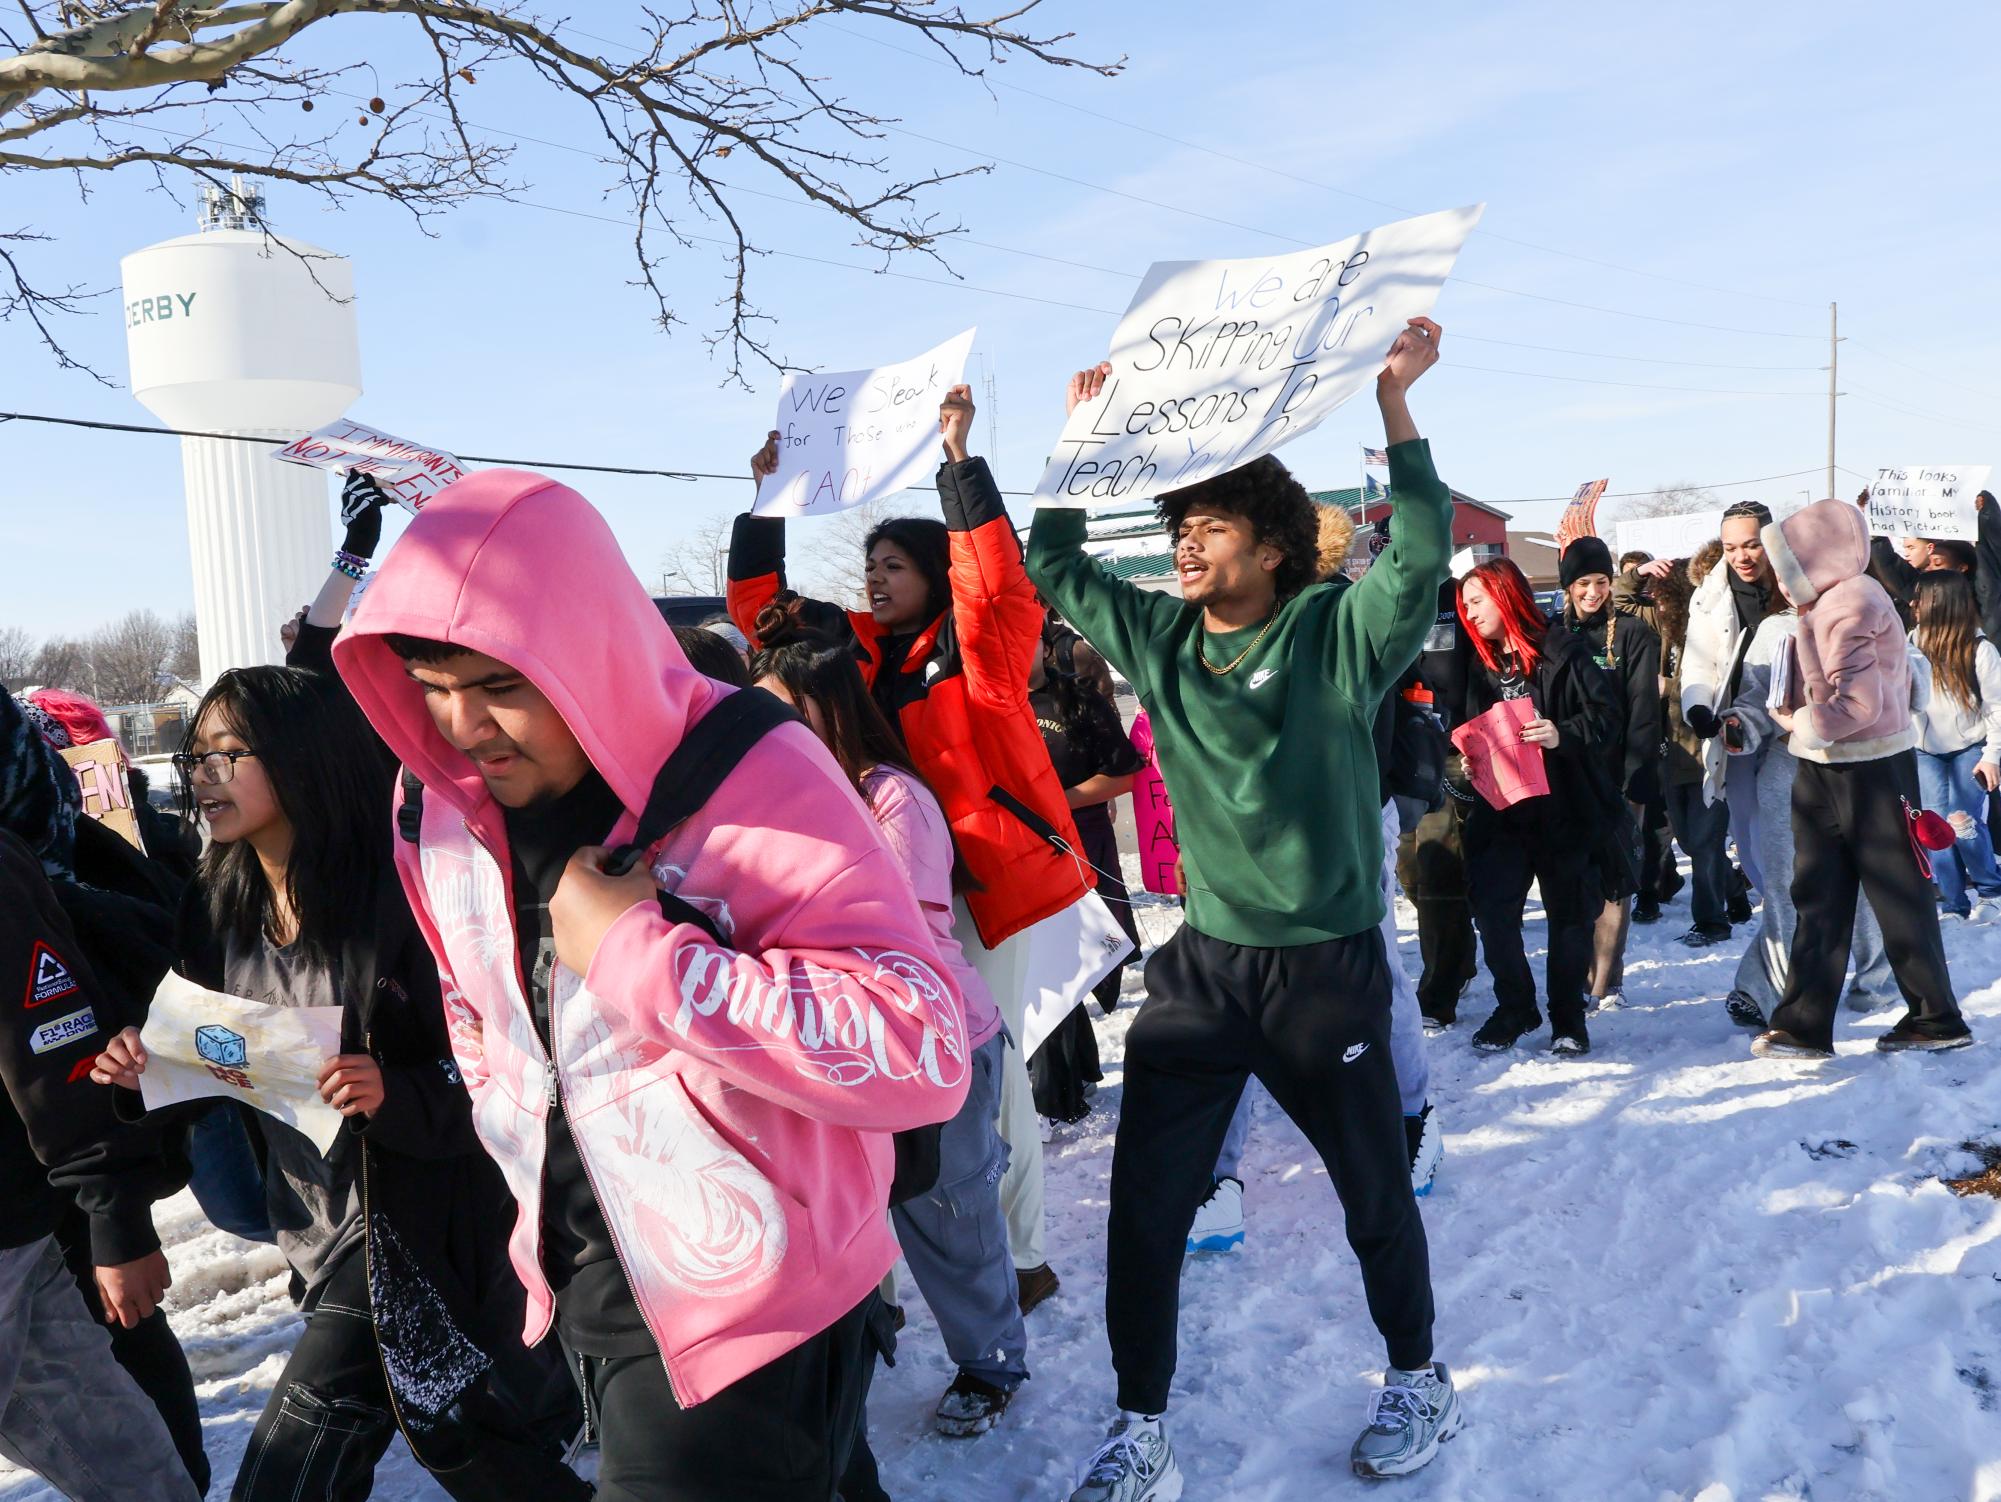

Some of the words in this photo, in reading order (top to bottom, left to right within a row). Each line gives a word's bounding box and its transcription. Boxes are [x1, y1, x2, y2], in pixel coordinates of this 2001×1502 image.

[1215, 267, 1283, 311] We
[1293, 251, 1369, 302] are
[1293, 297, 1374, 360] Our
[791, 384, 846, 413] We
[1091, 379, 1259, 436] Lessons
[1280, 360, 1319, 418] To
[783, 422, 811, 448] for
[282, 436, 356, 462] NOT
[328, 423, 464, 485] IMMIGRANTS
[1057, 440, 1158, 498] Teach
[1878, 468, 1908, 480] This
[1919, 469, 1957, 482] looks
[1870, 518, 1895, 532] had
[1253, 668, 1270, 683] NIKE
[1346, 1042, 1363, 1056] NIKE
